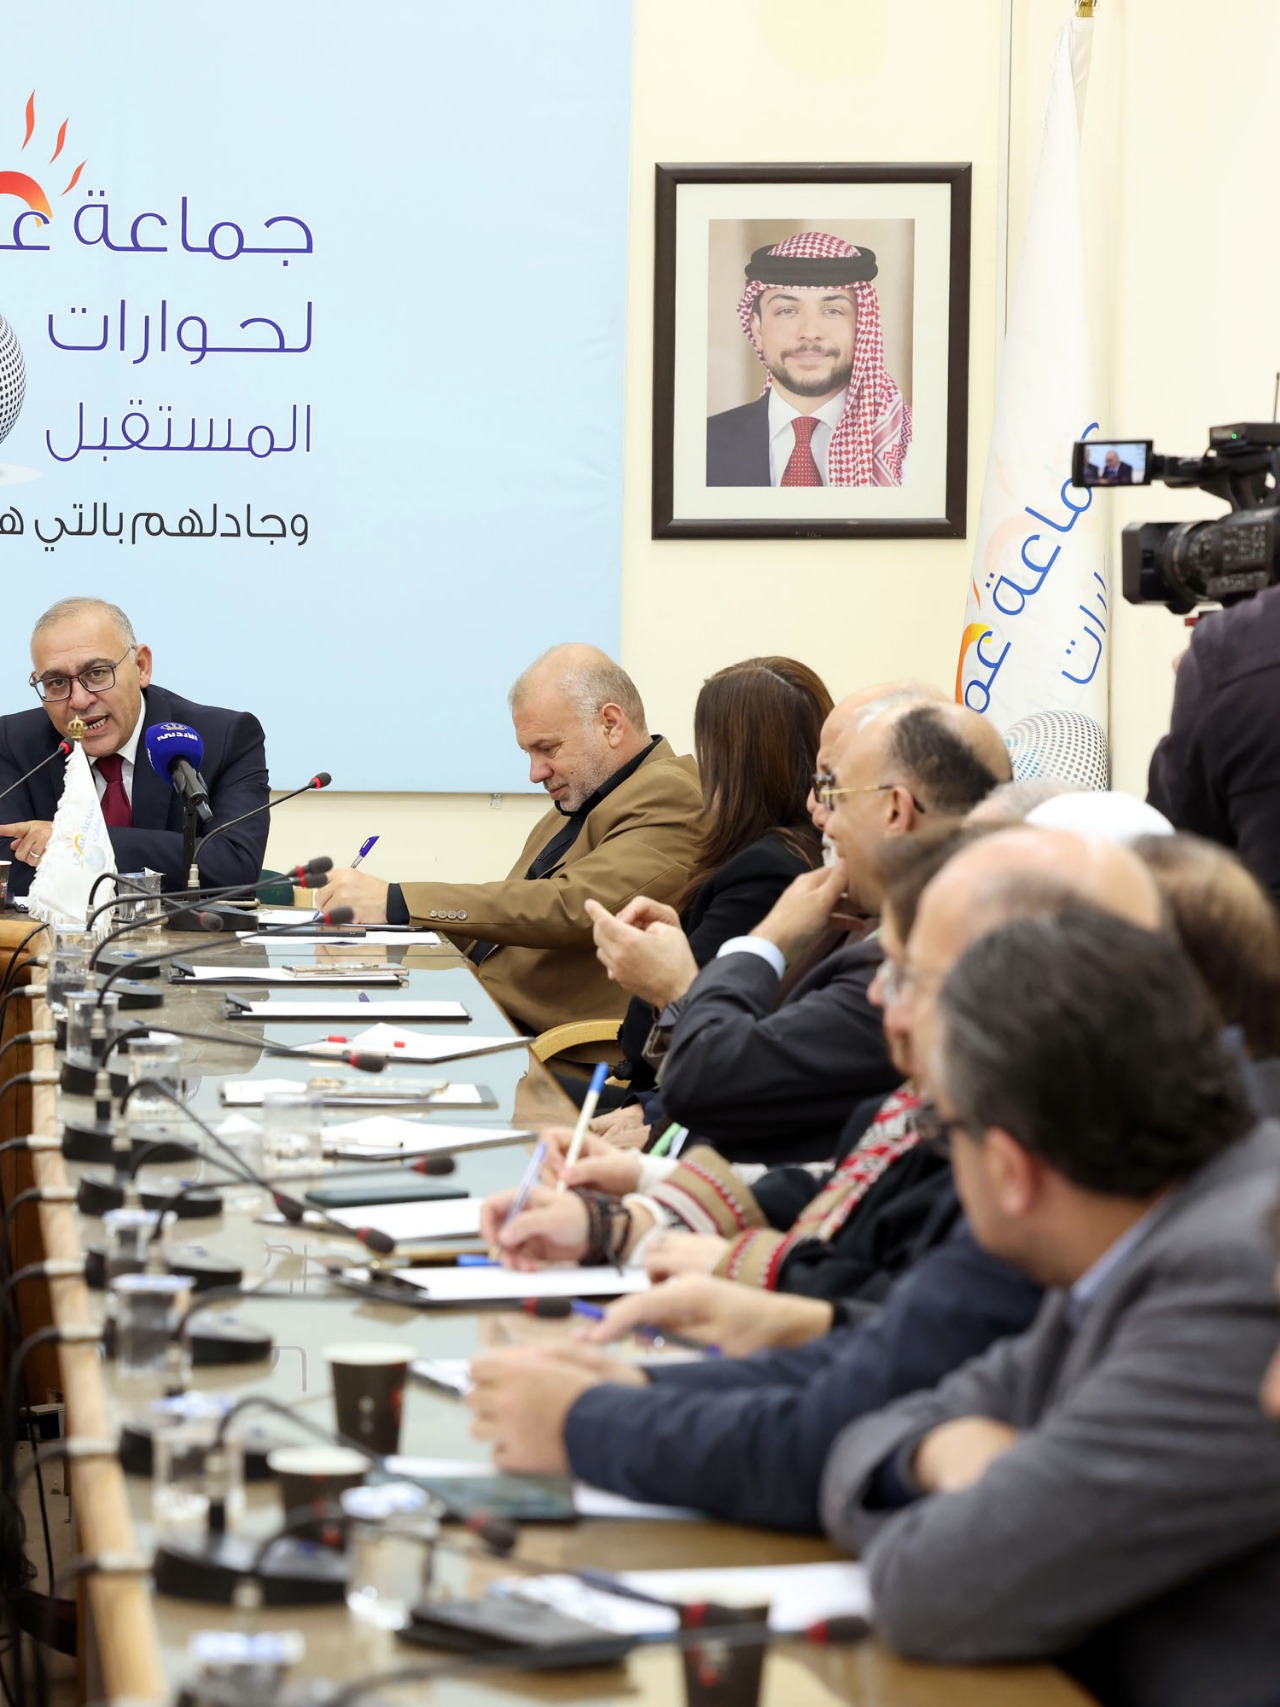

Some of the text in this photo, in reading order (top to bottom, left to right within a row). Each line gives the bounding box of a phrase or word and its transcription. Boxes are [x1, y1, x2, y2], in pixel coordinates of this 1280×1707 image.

[73, 190, 314, 267] جماعة
[48, 299, 313, 365] لحوارات
[45, 400, 312, 463] المستقبل
[34, 502, 124, 552] بالتي
[131, 503, 310, 546] وجادلهم
[964, 630, 1012, 715] عم
